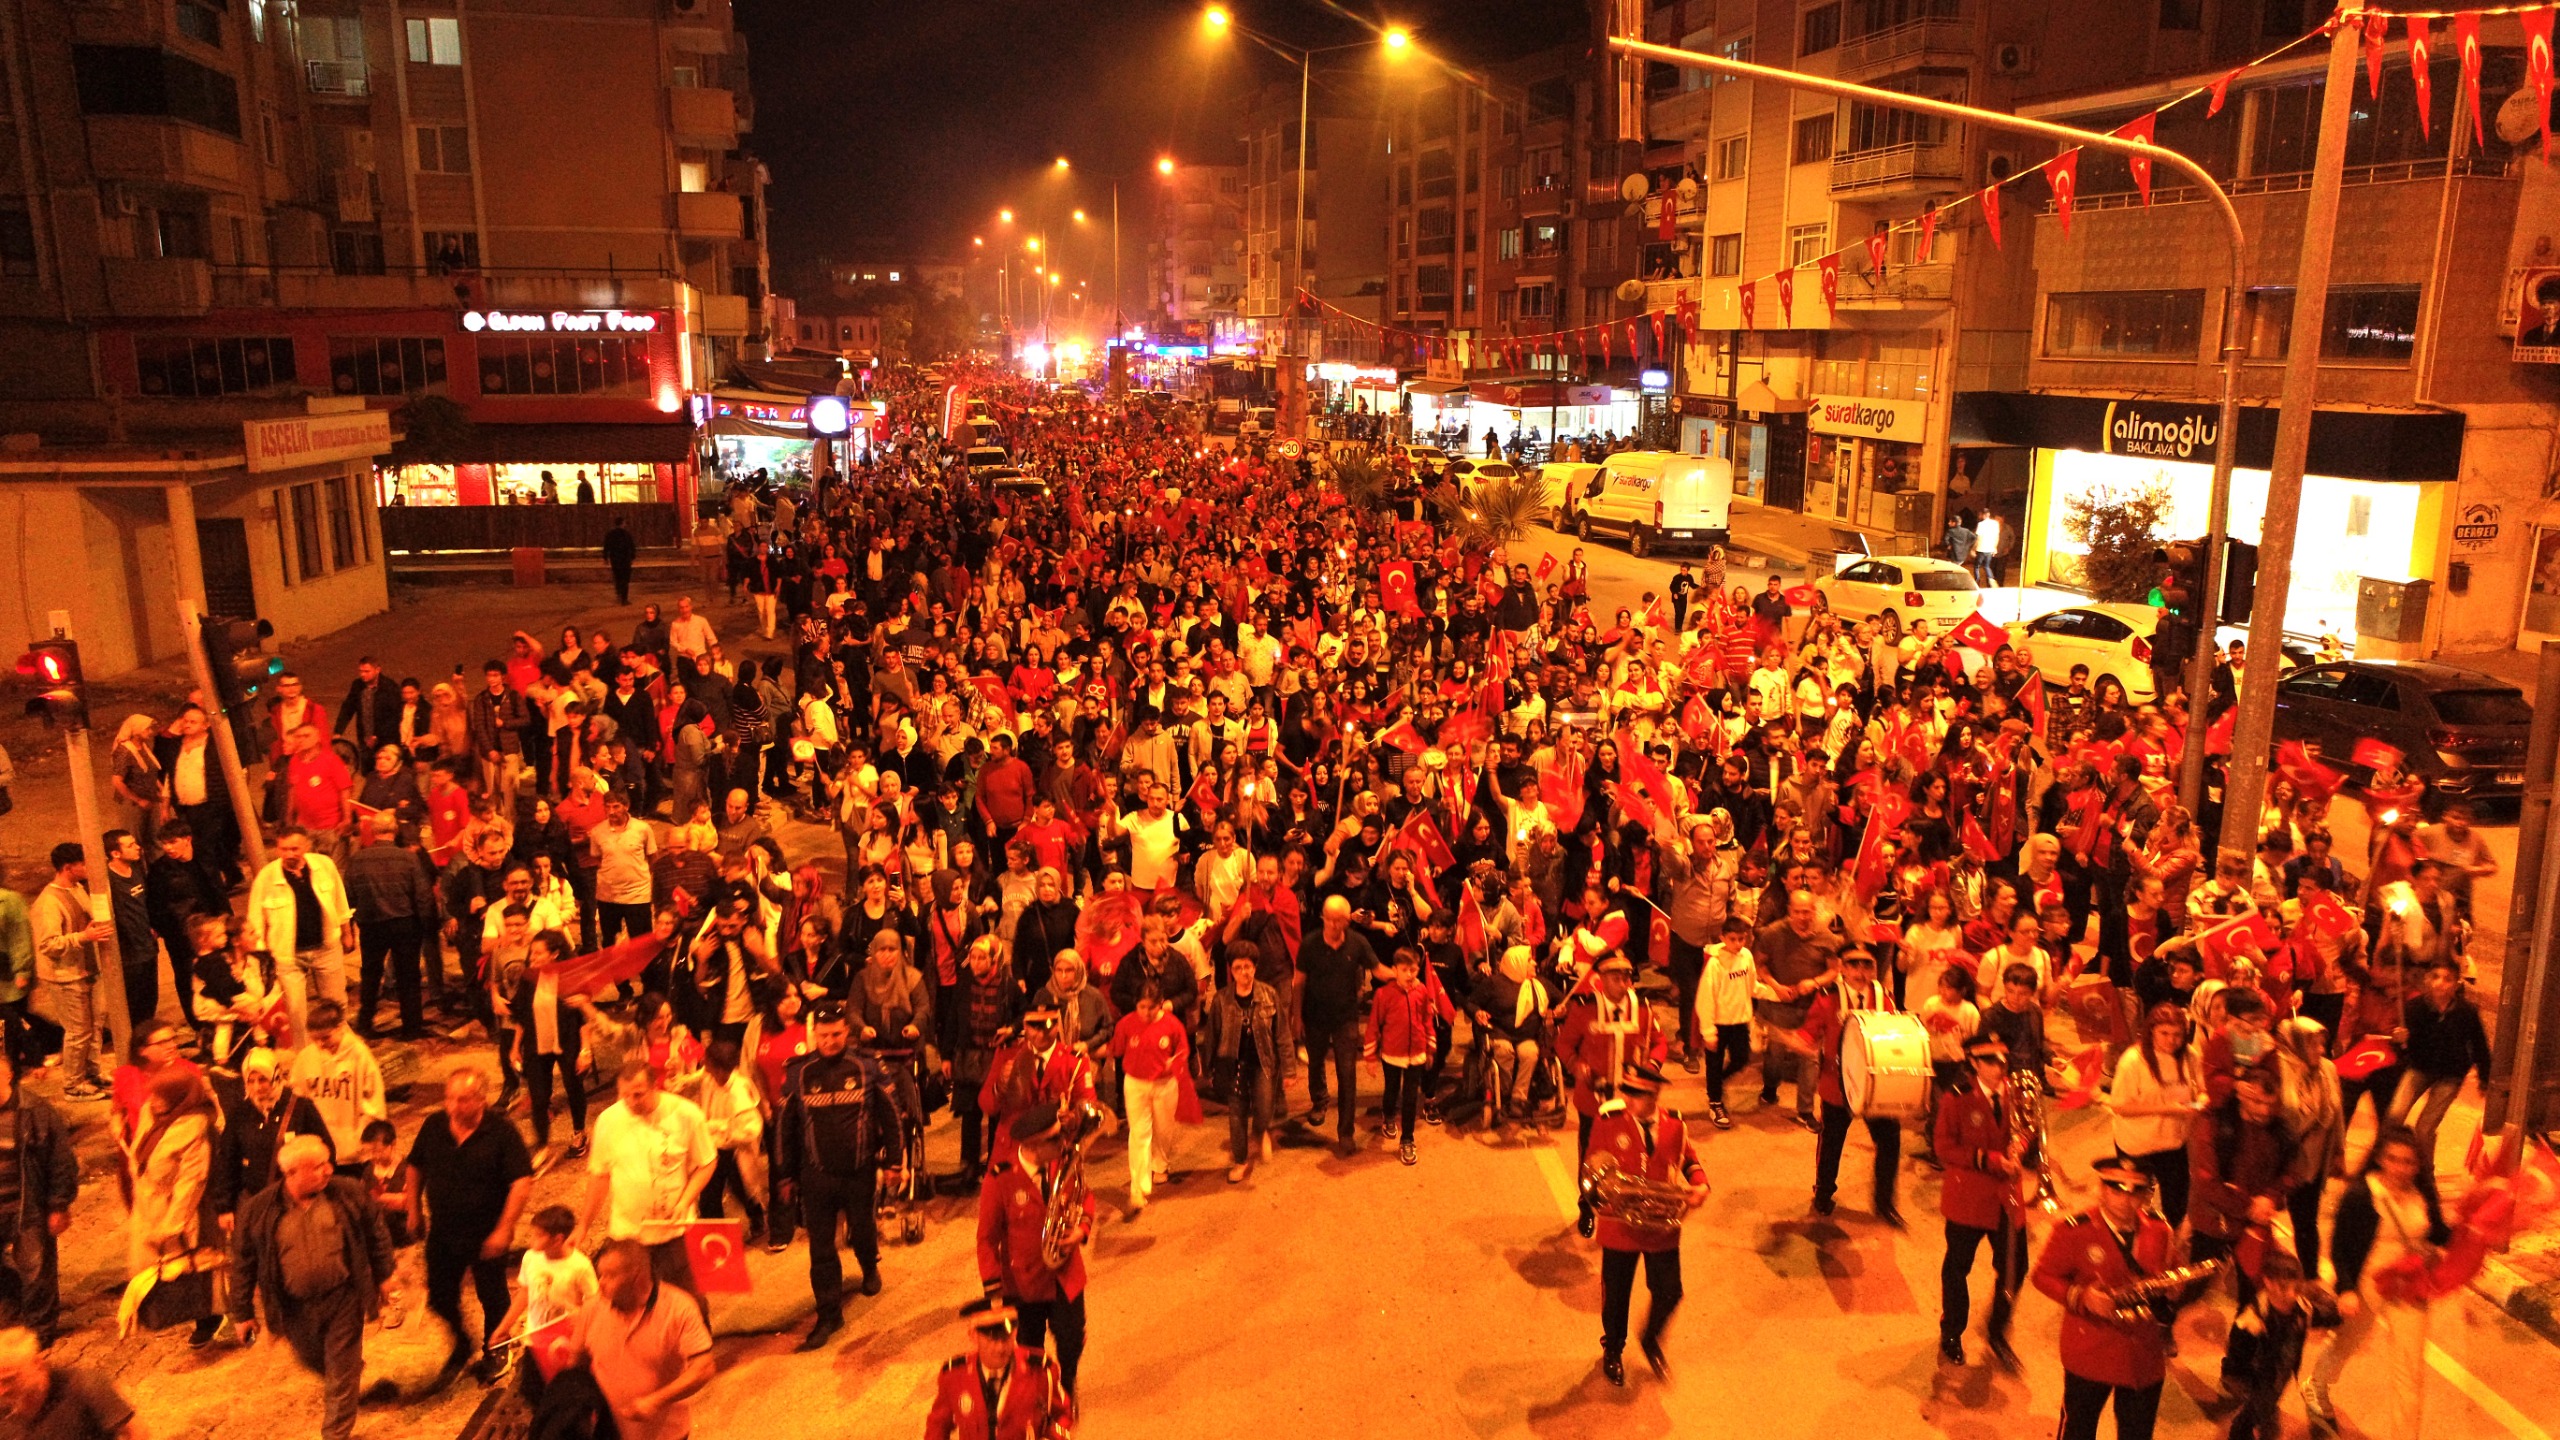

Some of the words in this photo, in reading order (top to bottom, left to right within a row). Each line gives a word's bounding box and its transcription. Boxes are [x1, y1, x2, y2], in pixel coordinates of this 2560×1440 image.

[1825, 402, 1895, 433] süratkargo
[2113, 410, 2218, 458] alimoğlu
[1285, 443, 1298, 454] 30
[2126, 440, 2175, 457] BAKLAVA
